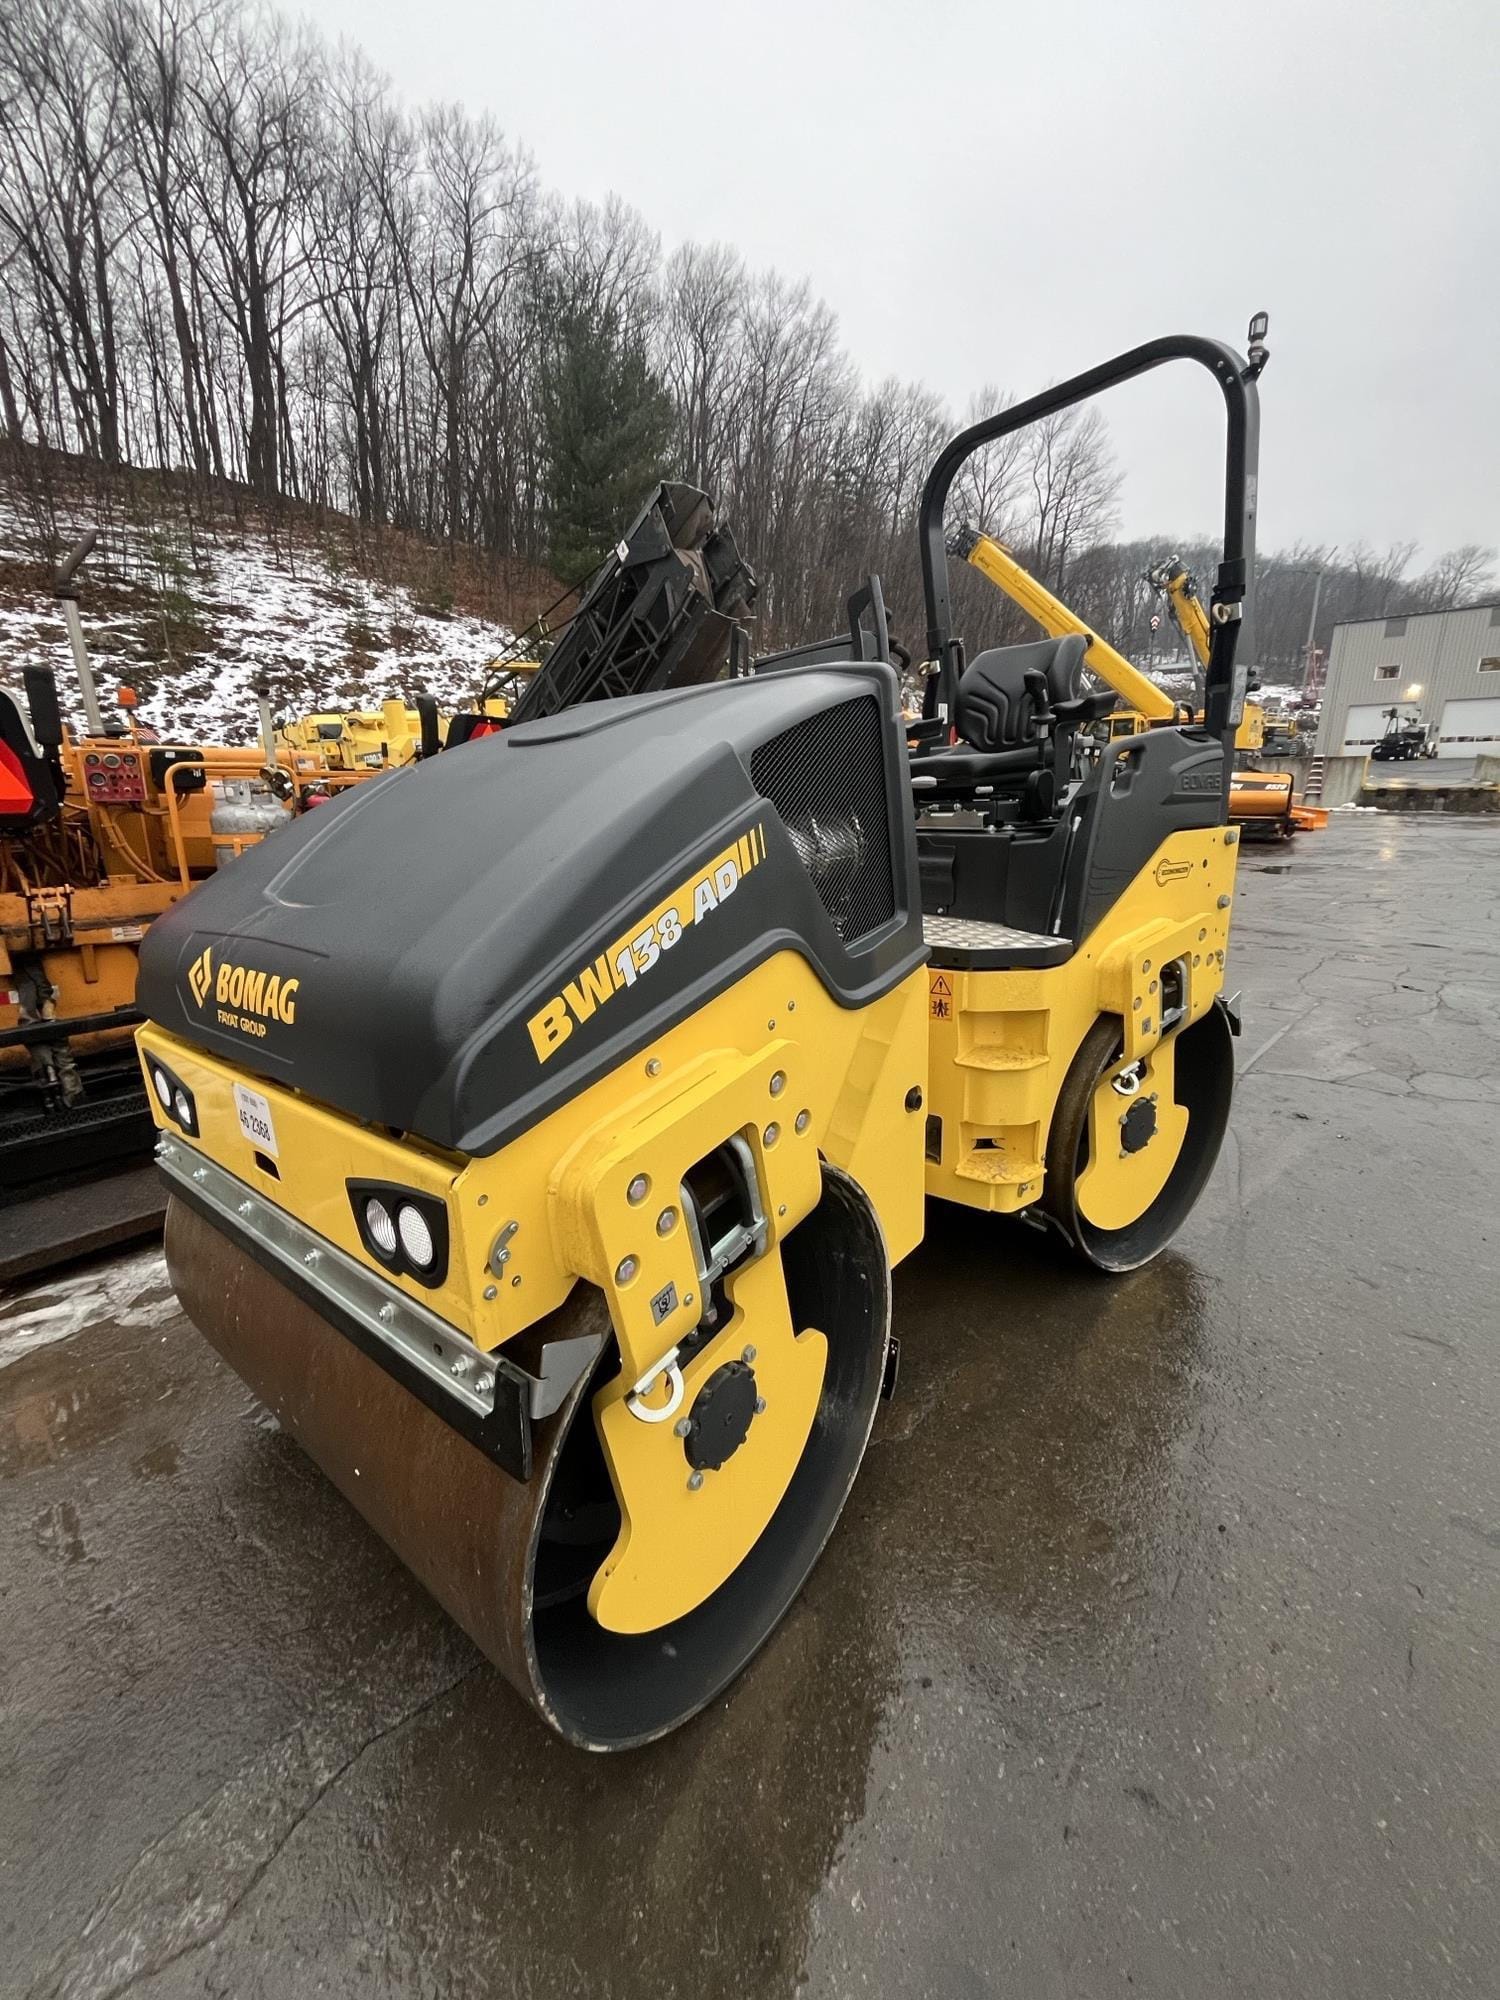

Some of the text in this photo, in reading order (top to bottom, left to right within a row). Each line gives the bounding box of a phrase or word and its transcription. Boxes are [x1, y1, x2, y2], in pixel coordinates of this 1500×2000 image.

[693, 859, 740, 926] AD
[216, 962, 300, 1025] BOMAG
[217, 1008, 267, 1038] FAYAT GROUP
